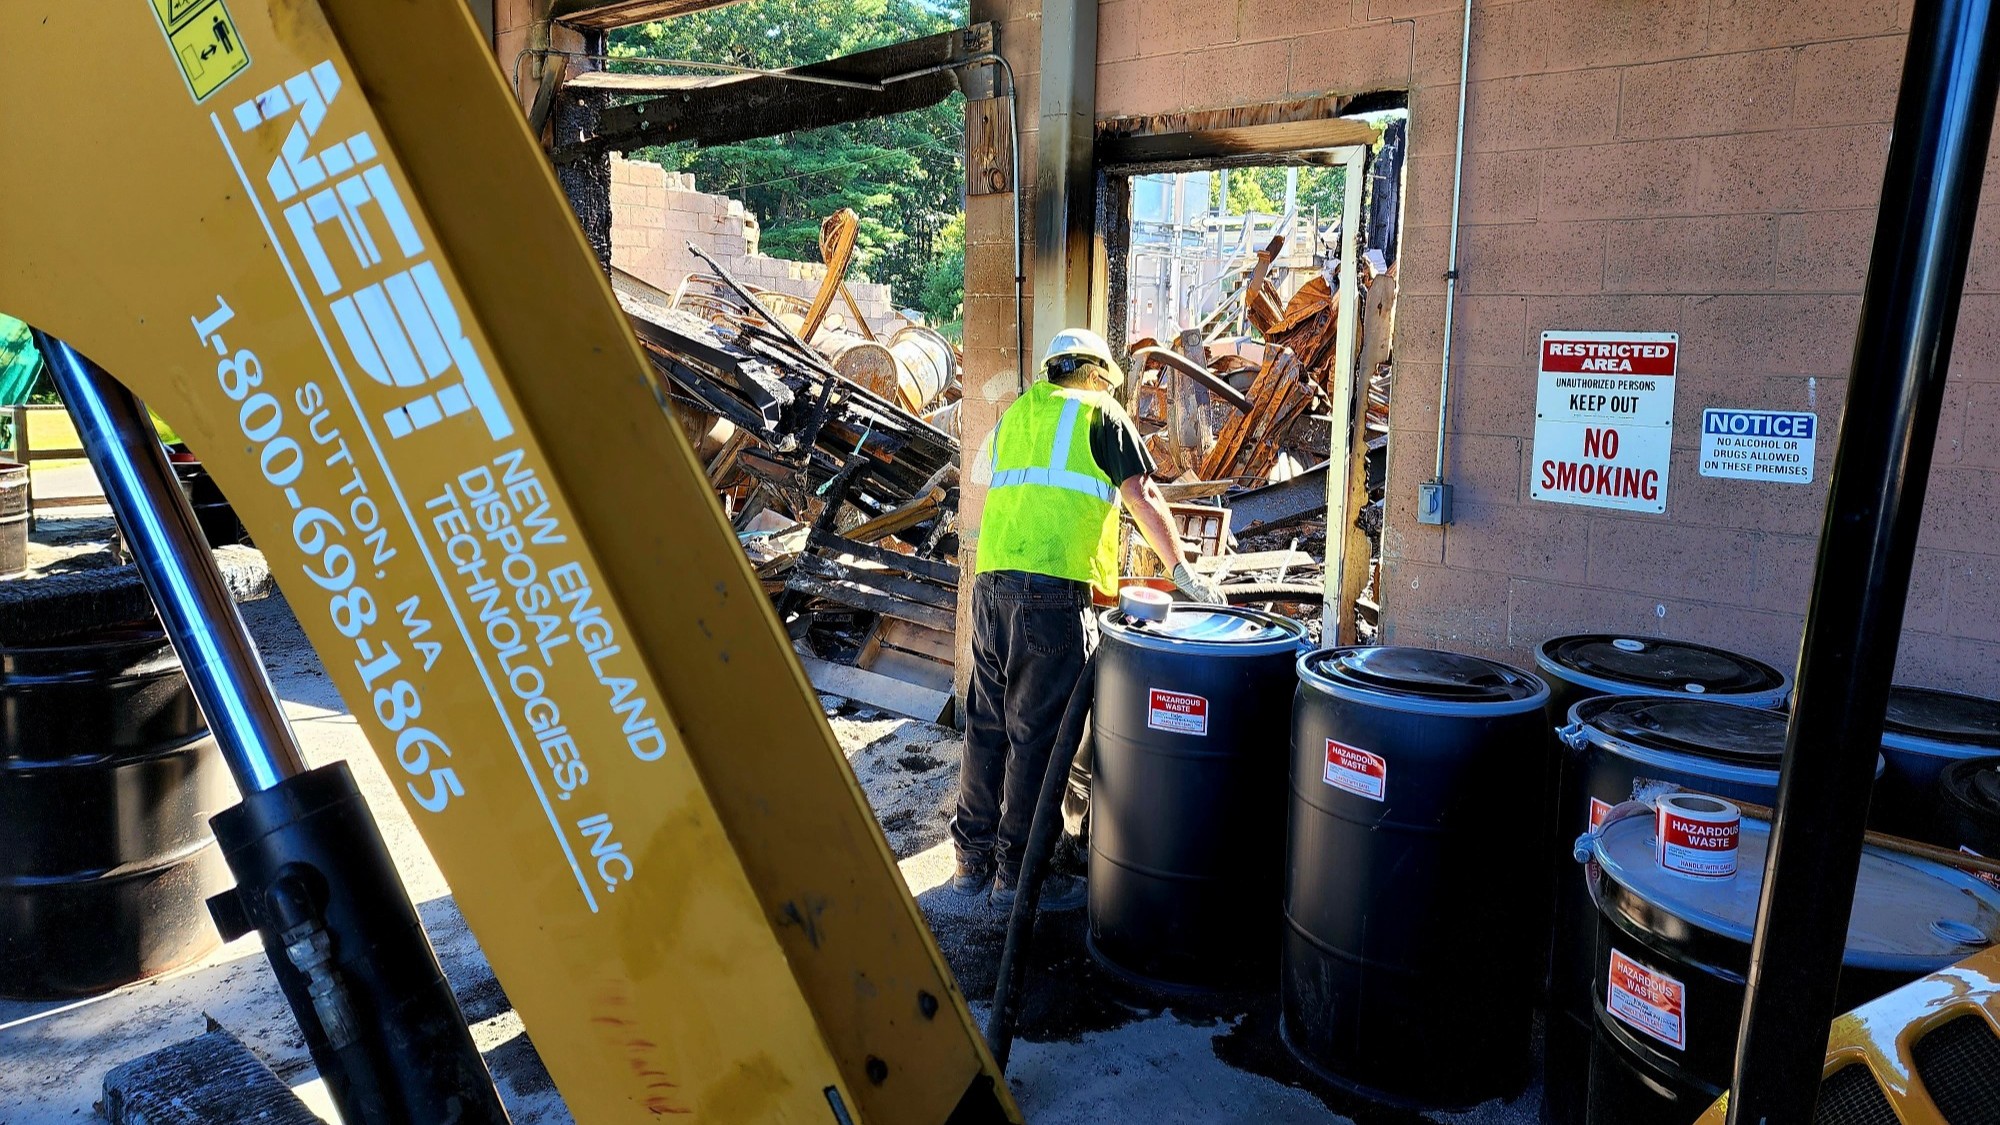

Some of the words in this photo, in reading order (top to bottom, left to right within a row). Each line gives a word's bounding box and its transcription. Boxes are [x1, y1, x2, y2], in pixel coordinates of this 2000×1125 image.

[1549, 343, 1670, 359] RESTRICTED
[1581, 358, 1633, 372] AREA
[1556, 378, 1616, 390] UNAUTHORIZED
[1618, 380, 1656, 392] PERSONS
[1569, 394, 1607, 412] KEEP
[1610, 396, 1639, 413] OUT
[1709, 413, 1808, 437] NOTICE
[1583, 427, 1619, 460] NO
[1717, 437, 1731, 446] NO
[1734, 438, 1781, 449] ALCOHOL
[1783, 441, 1798, 450] OR
[1713, 449, 1747, 459] DRUGS
[1750, 451, 1800, 463] ALLOWED
[1704, 460, 1719, 470] ON
[1722, 461, 1752, 472] THESE
[1755, 463, 1808, 476] PREMISES
[1541, 459, 1659, 501] SMOKING
[296, 381, 397, 579] SUTTON,
[396, 596, 443, 673] MA
[191, 295, 465, 813] 1-800-698-1865
[458, 466, 569, 667] DISPOSAL
[494, 448, 567, 545] NEW
[548, 561, 667, 763] ENGLAND
[425, 484, 589, 801] TECHNOLOGIES,
[577, 813, 634, 893] INC.
[1156, 694, 1201, 707] HAZARDOUS
[1165, 702, 1191, 713] WASTE
[1332, 746, 1378, 767] HAZARDOUS
[1340, 756, 1368, 772] WASTE
[1672, 820, 1739, 837] HAZARDOUS
[1688, 835, 1730, 848] WASTE
[1617, 961, 1674, 998] HAZARDOUS
[1626, 978, 1659, 1004] WASTE
